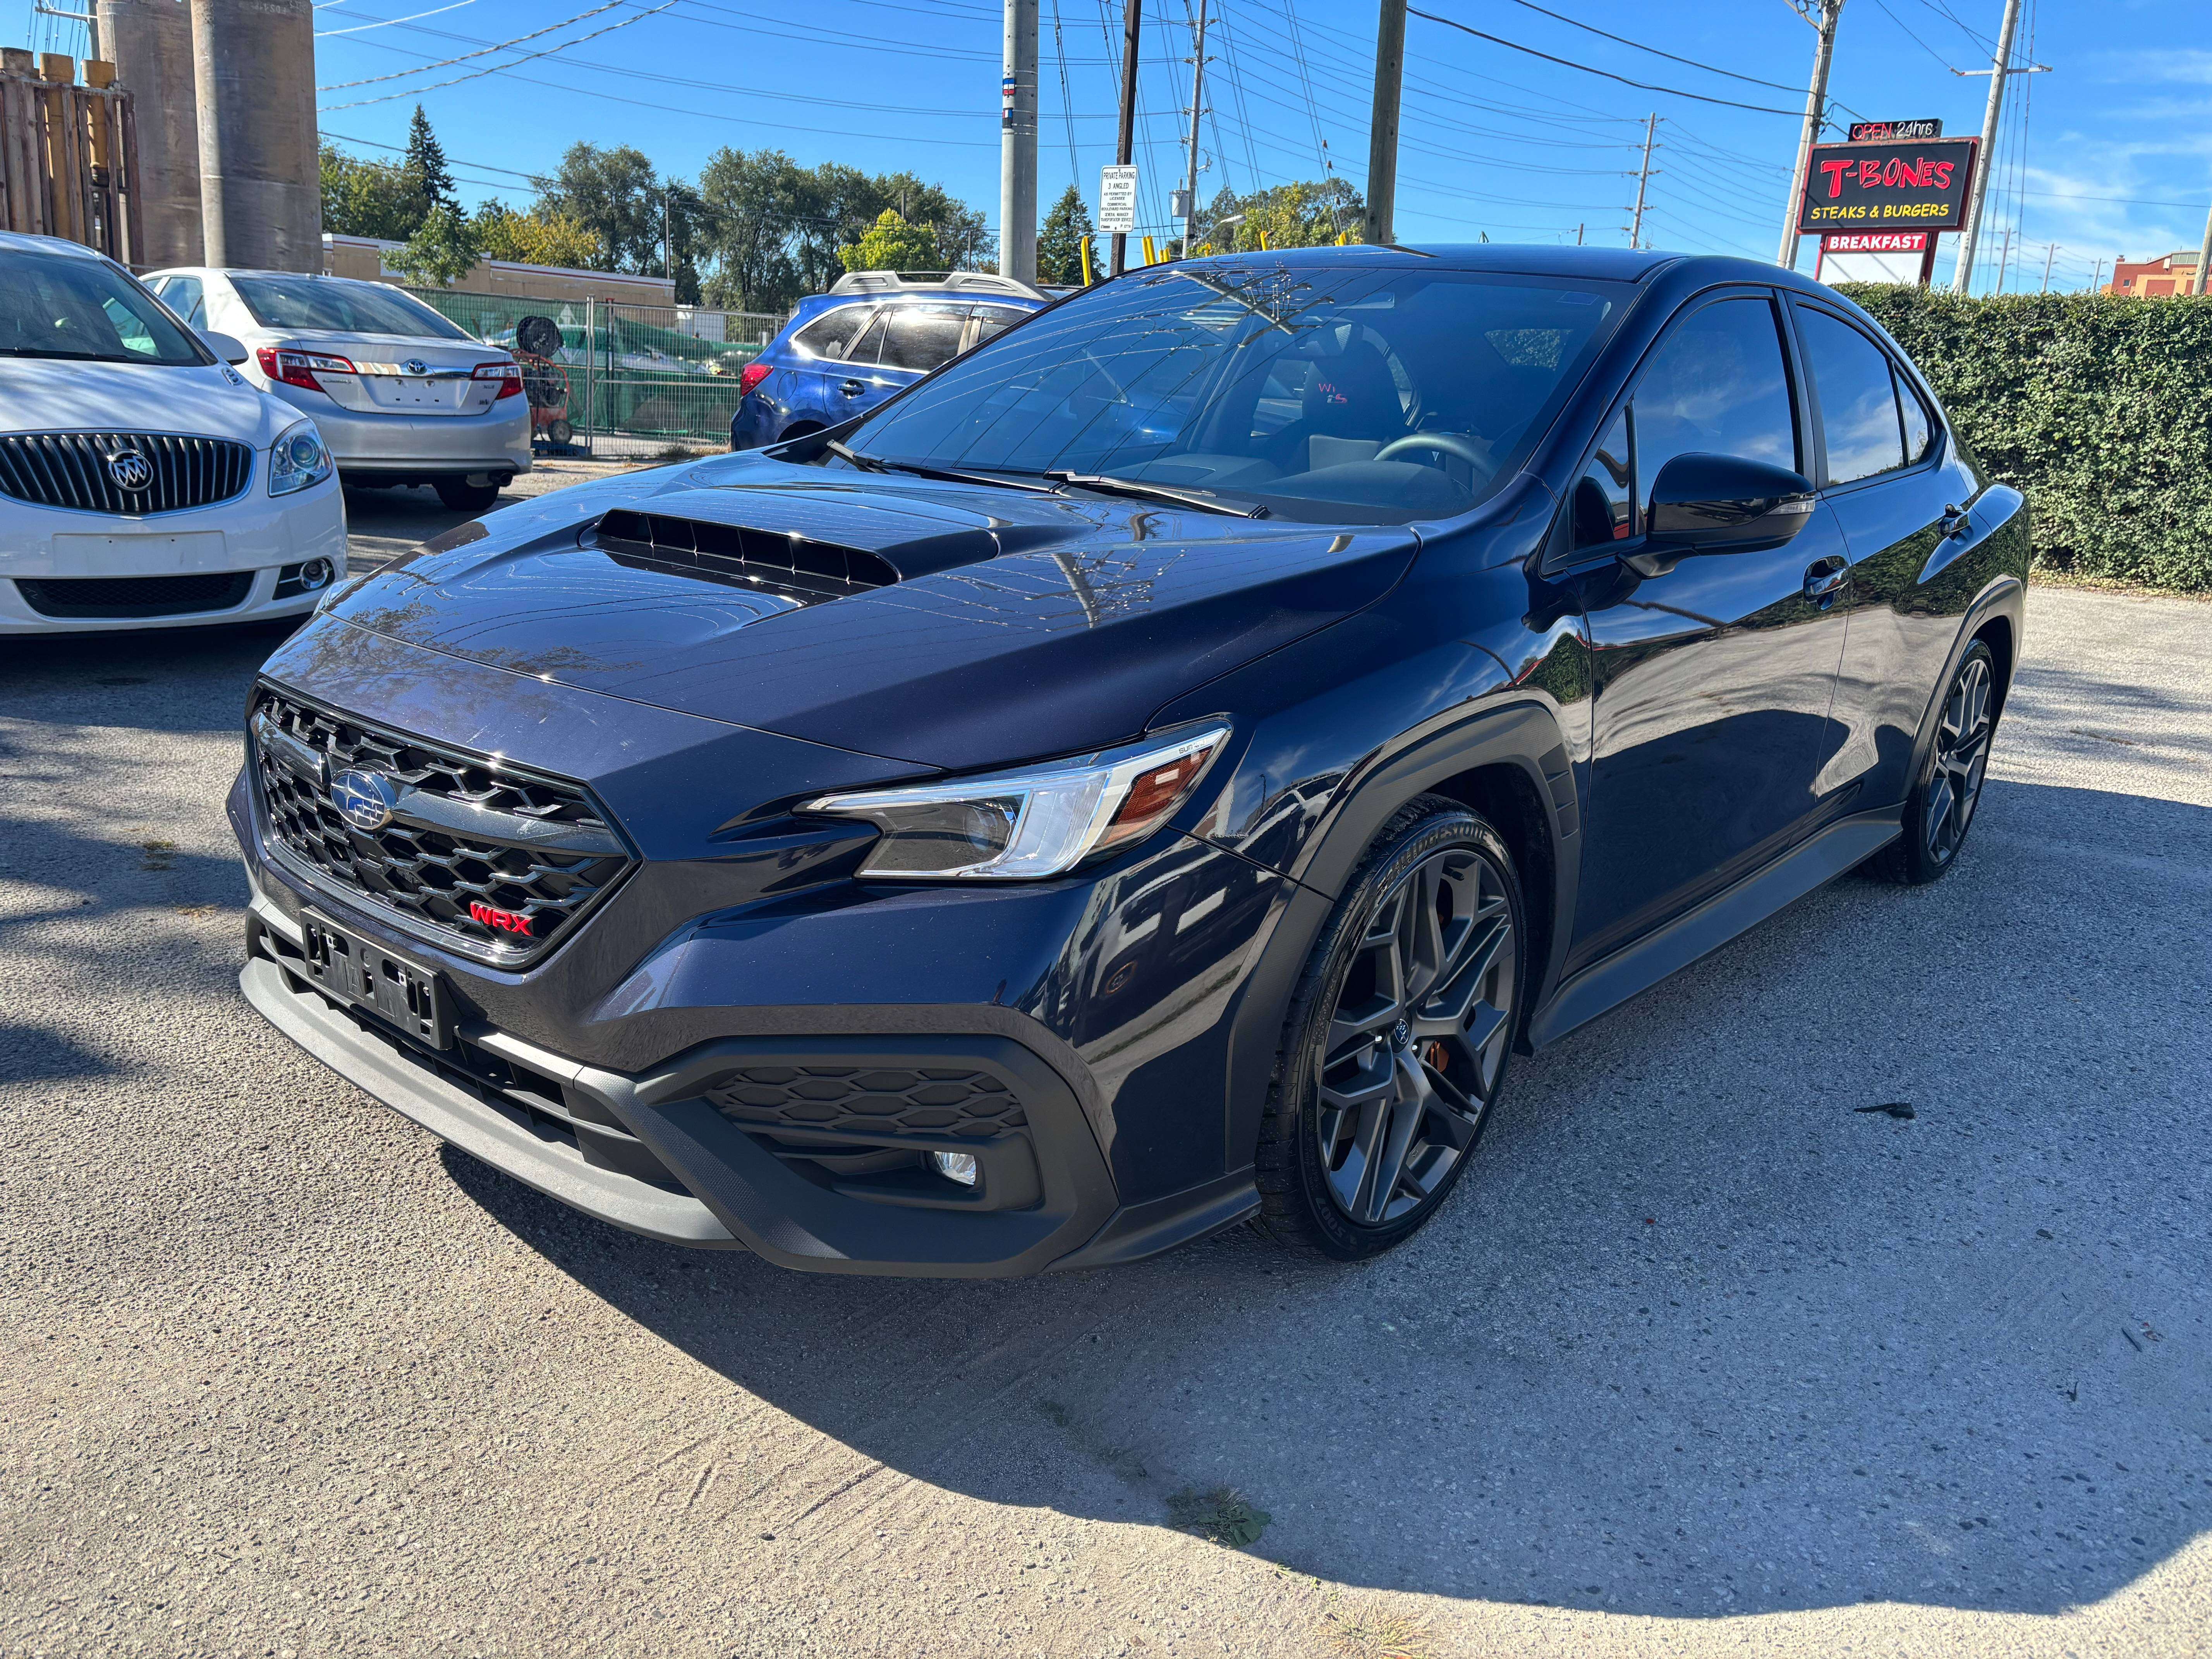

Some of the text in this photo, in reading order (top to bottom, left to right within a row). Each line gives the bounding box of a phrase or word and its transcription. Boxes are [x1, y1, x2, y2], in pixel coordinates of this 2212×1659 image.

[1853, 123, 1892, 140] OPEN
[1821, 157, 1954, 198] T-BONES
[1811, 204, 1949, 219] STEAKS & BURGERS
[1829, 235, 1922, 249] BREAKFAST
[470, 902, 533, 936] WRX
